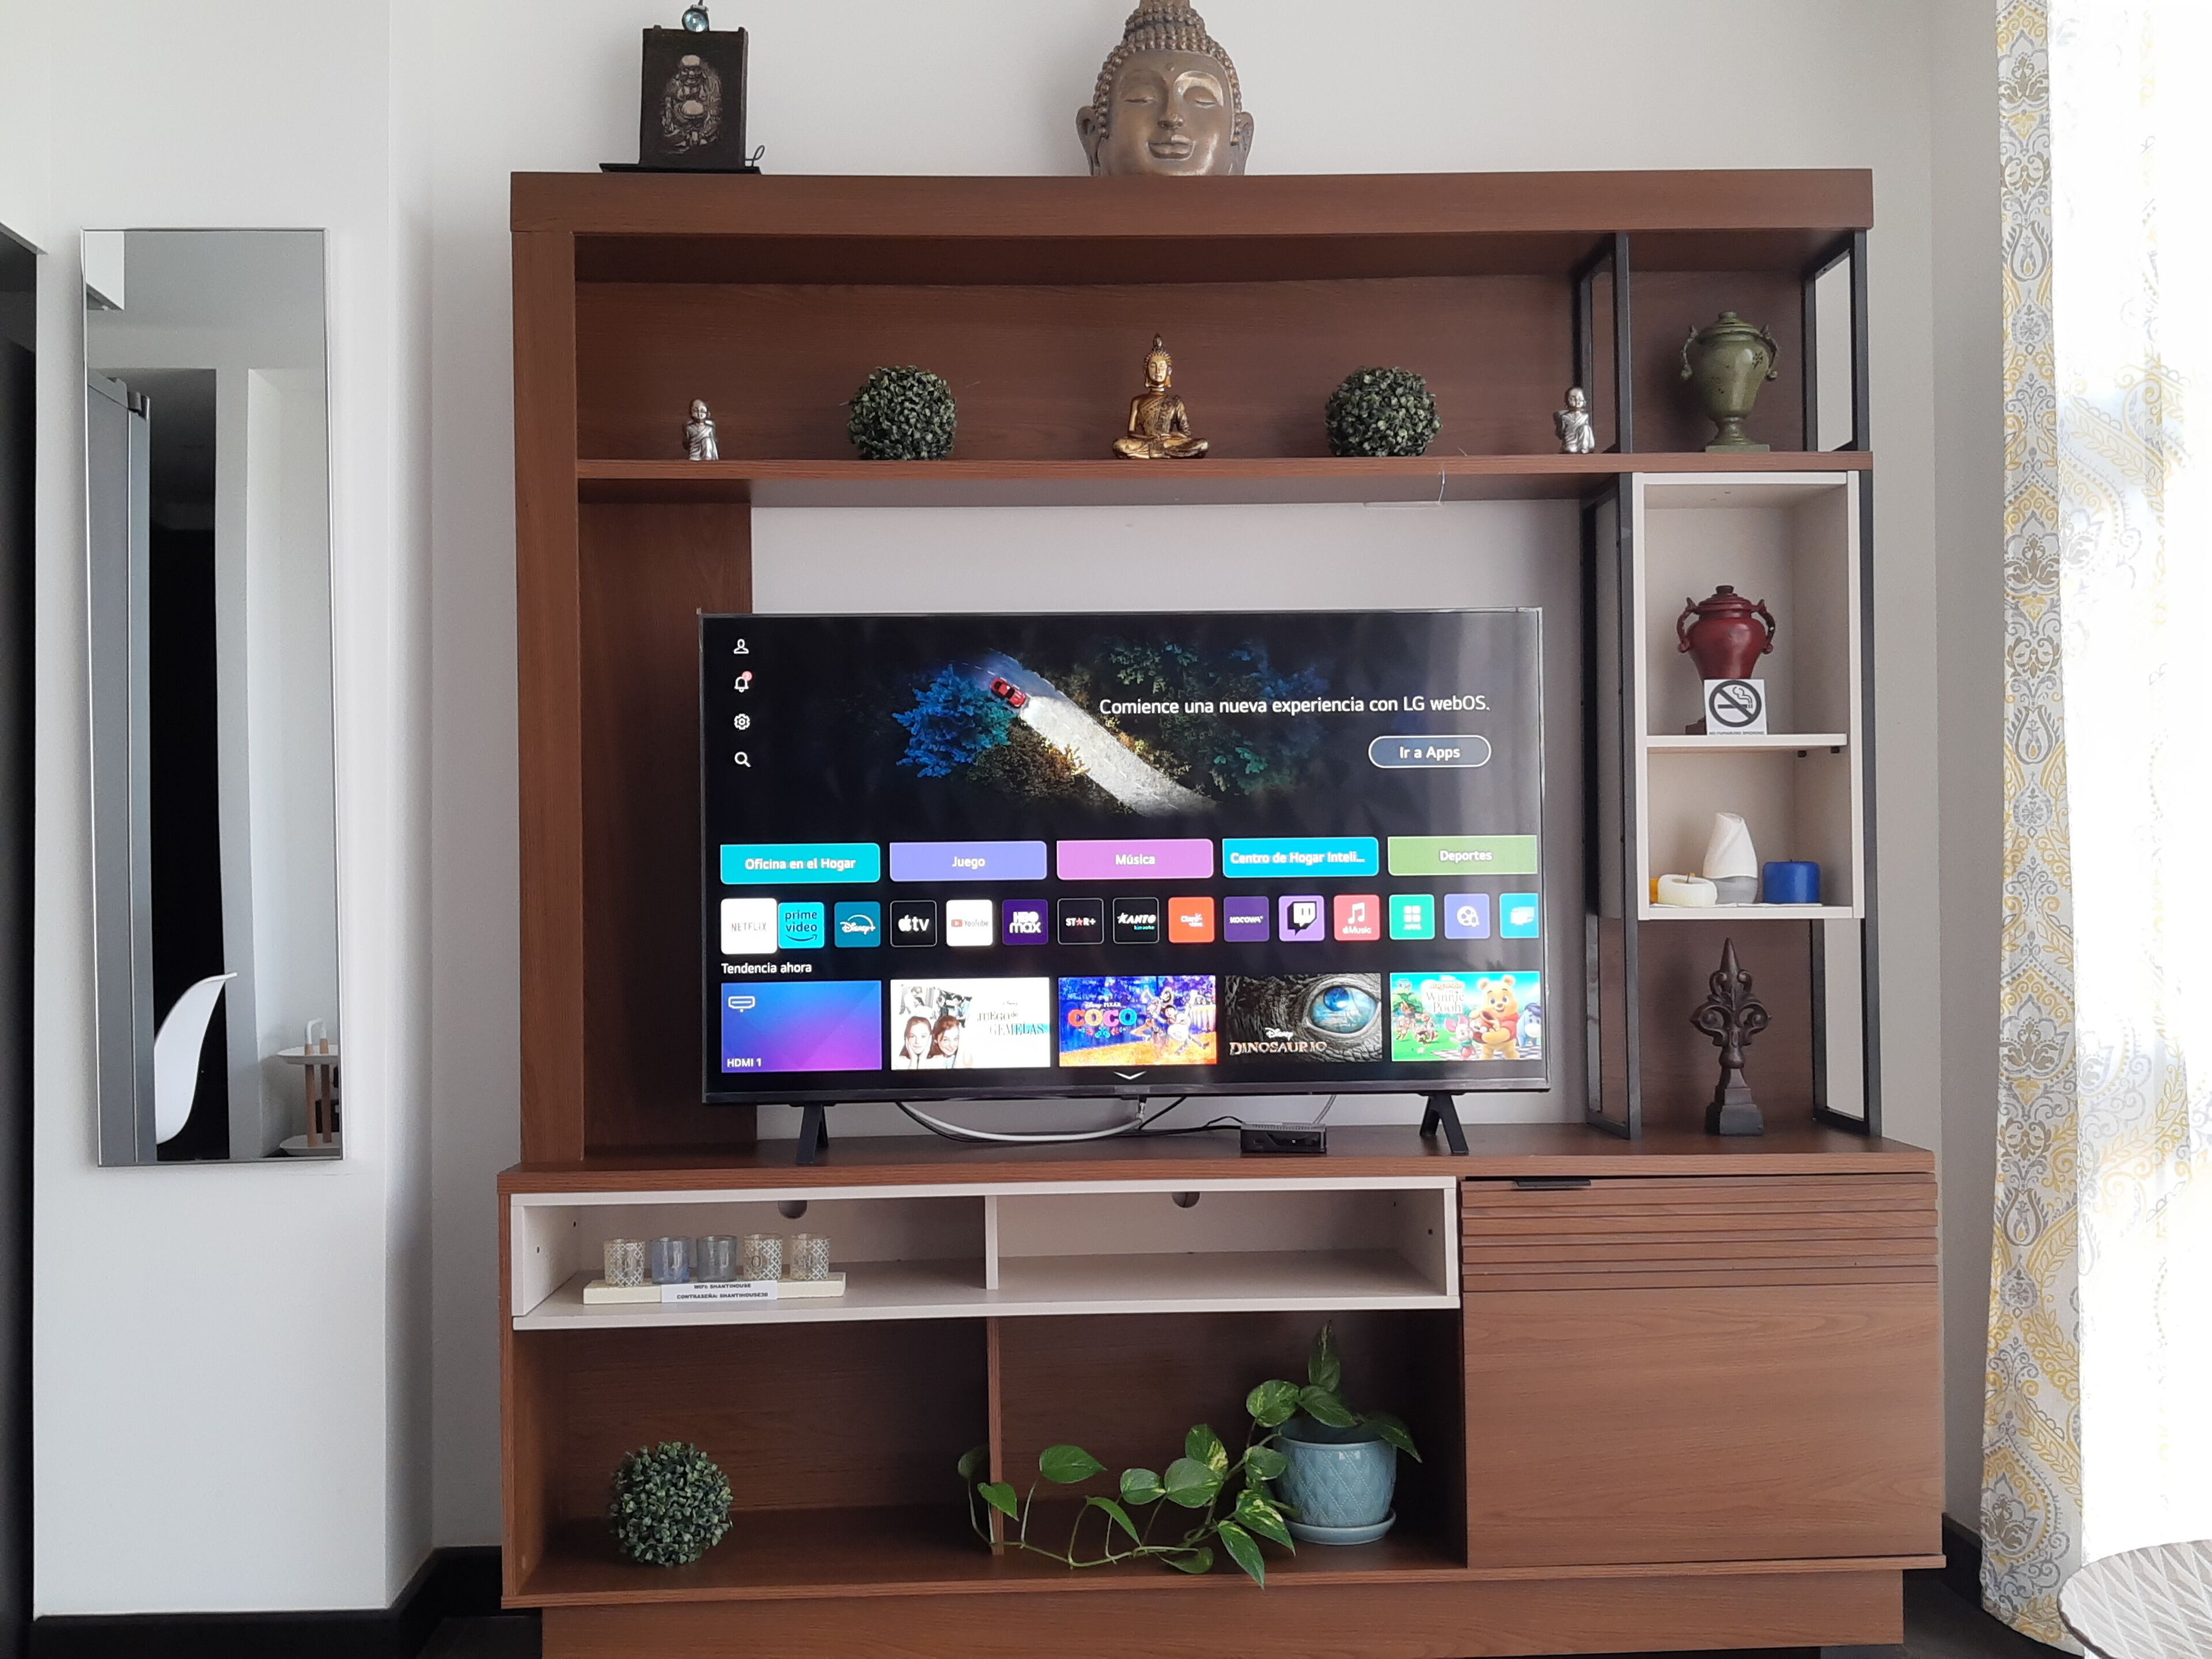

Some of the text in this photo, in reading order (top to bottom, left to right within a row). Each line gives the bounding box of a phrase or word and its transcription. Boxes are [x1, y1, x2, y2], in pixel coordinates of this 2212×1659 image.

[1100, 695, 1490, 716] Comience una nueva experiencia con LG webOS.
[1399, 747, 1460, 761] Ir a Apps
[1115, 854, 1156, 865] Música
[1230, 851, 1365, 866] Centro de Hogar Inteli...
[1440, 850, 1493, 863] Deportes
[745, 857, 856, 872] Oficina en el Hogar
[952, 856, 986, 870] Juego
[785, 910, 817, 922] prime
[1013, 911, 1039, 923] HBO
[1117, 913, 1157, 924] KANTO
[731, 922, 767, 932] NETFLIX
[785, 922, 817, 932] video
[912, 916, 929, 931] tv
[964, 919, 989, 927] YouTube
[1009, 922, 1041, 933] max
[721, 961, 812, 974] Tendencia ahora
[1426, 991, 1465, 1002] Winnie
[1433, 1002, 1461, 1013] Pooh
[1068, 1008, 1138, 1027] COCO
[989, 1022, 1044, 1035] GEMELAS
[1229, 1041, 1327, 1056] DINOSAURIO
[727, 1058, 762, 1067] HDMI 1
